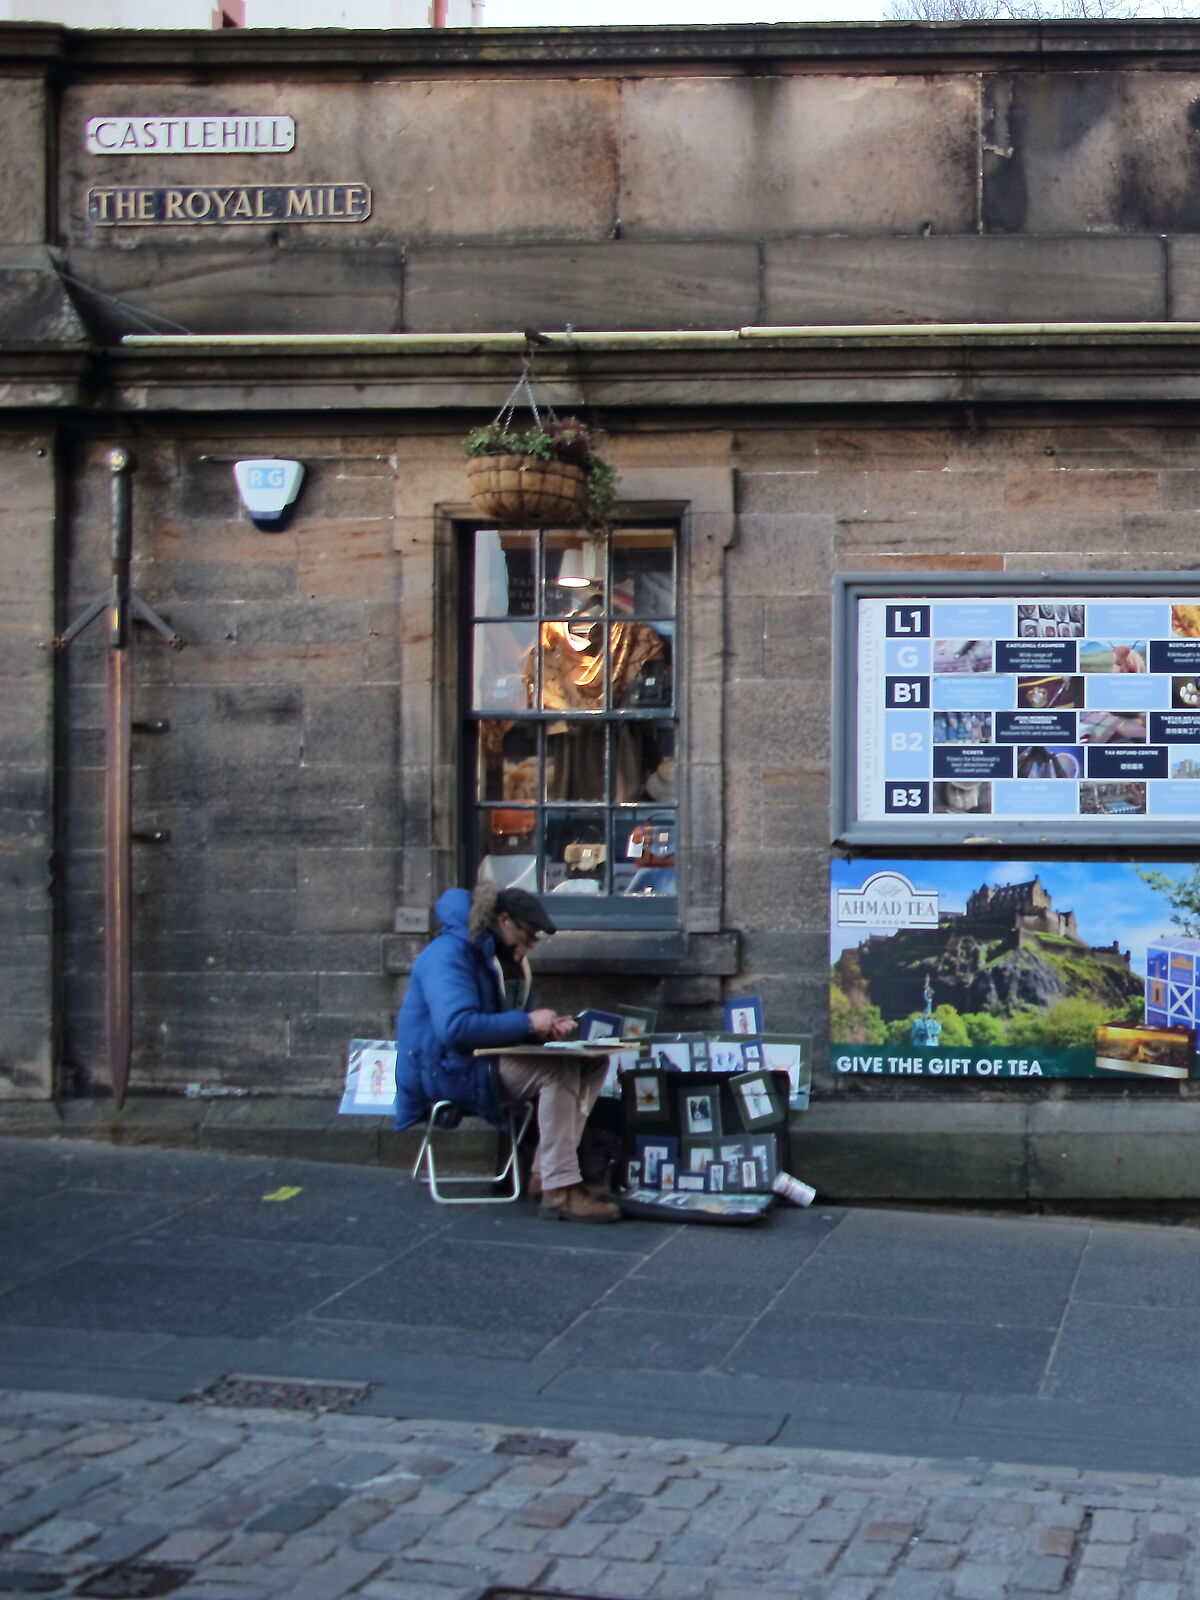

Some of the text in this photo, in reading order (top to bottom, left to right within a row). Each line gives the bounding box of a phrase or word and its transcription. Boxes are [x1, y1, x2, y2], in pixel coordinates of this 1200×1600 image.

[94, 120, 287, 149] CASTLEHILL
[95, 188, 363, 220] THE ROYAL MILE
[894, 611, 921, 633] L1
[897, 646, 919, 669] G
[894, 683, 921, 703] B1
[891, 732, 923, 752] B2
[892, 788, 921, 807] B3
[841, 901, 936, 916] AHMAD TEA
[836, 1055, 1043, 1076] GIVE THE GIFT OF TEA
